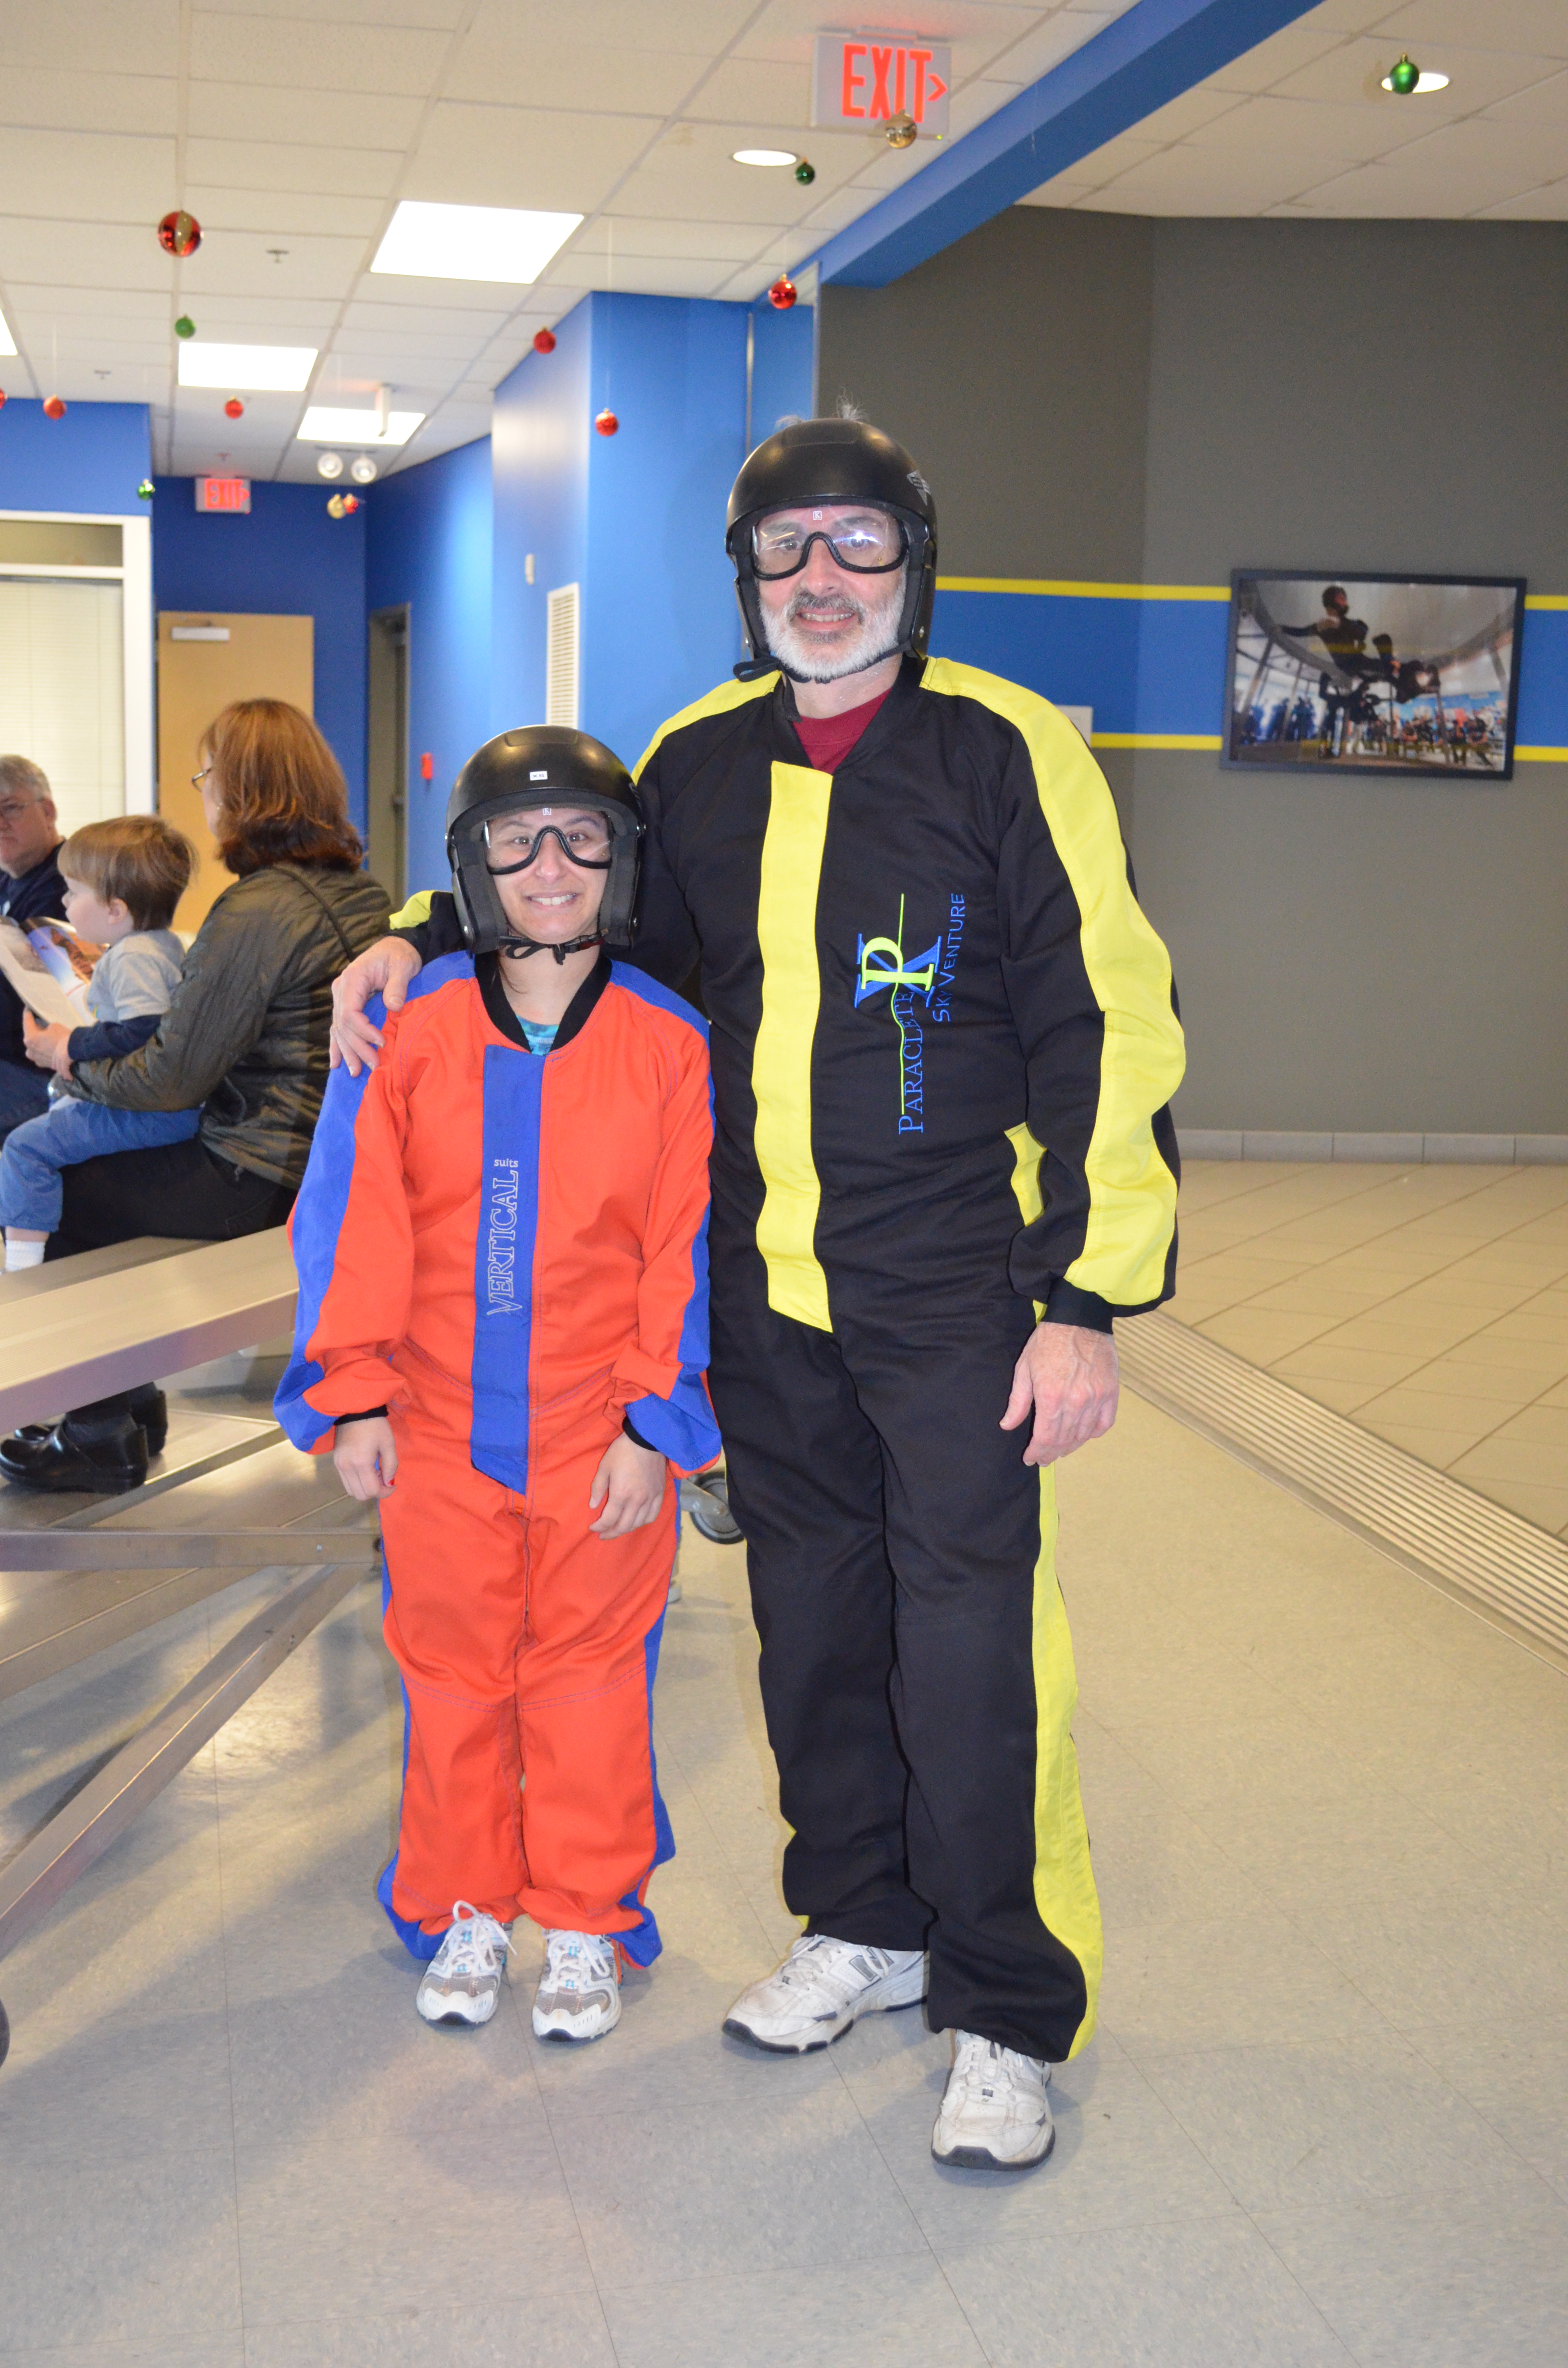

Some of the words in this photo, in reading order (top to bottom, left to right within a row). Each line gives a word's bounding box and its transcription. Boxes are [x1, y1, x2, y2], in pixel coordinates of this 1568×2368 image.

[842, 42, 933, 123] EXIT
[205, 479, 243, 509] EXIT
[894, 991, 923, 1135] PARACLETE
[494, 1158, 518, 1168] suits
[487, 1170, 523, 1315] VERTICAL
